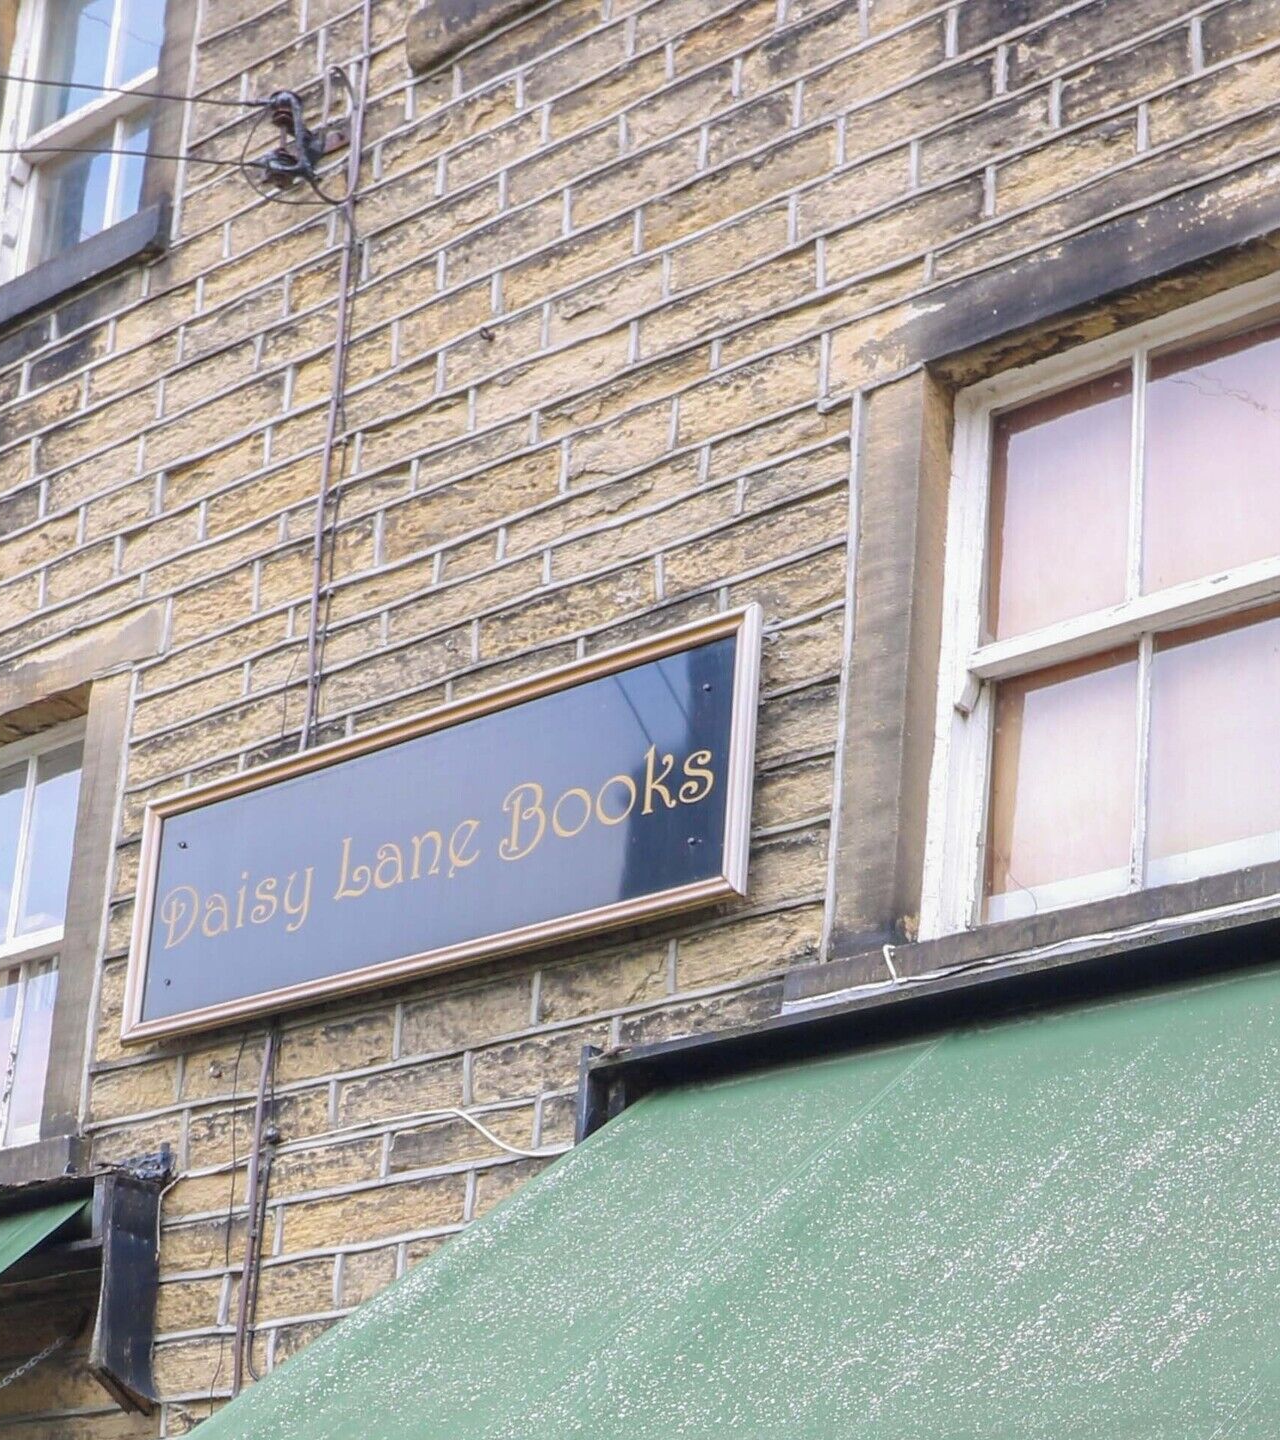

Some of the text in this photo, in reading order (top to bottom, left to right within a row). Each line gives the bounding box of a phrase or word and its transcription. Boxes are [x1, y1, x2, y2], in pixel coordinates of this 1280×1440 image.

[161, 742, 715, 949] Daisy Lane Books
